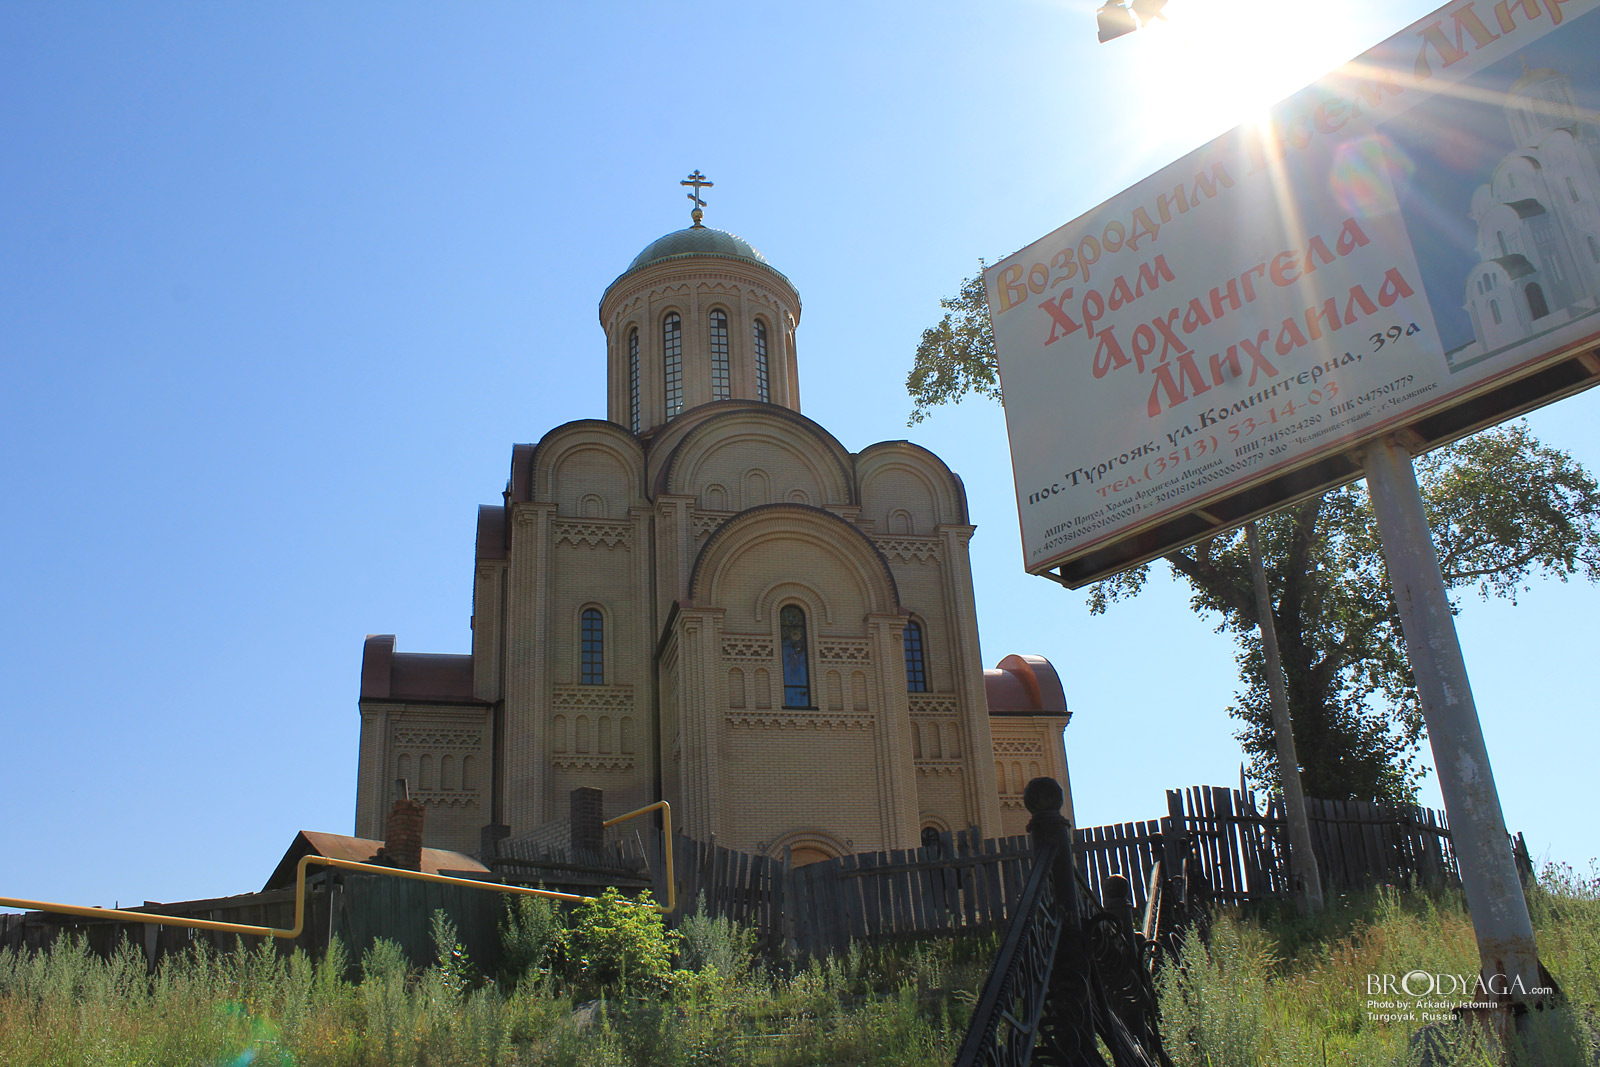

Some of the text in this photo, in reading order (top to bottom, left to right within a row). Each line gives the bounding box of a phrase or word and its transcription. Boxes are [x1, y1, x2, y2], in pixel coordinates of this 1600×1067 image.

[996, 161, 1236, 315] Возродим
[1038, 253, 1176, 347] Храм
[1092, 217, 1371, 379] Архангела
[1147, 266, 1415, 418] Михаила
[1368, 322, 1421, 353] 39а
[1105, 497, 1134, 514] Храма
[1135, 476, 1180, 500] Архангела
[1181, 459, 1223, 482] Михаила
[1234, 442, 1260, 458] ИНН
[1330, 399, 1356, 418] БИК
[1228, 381, 1339, 443] 53-14-03
